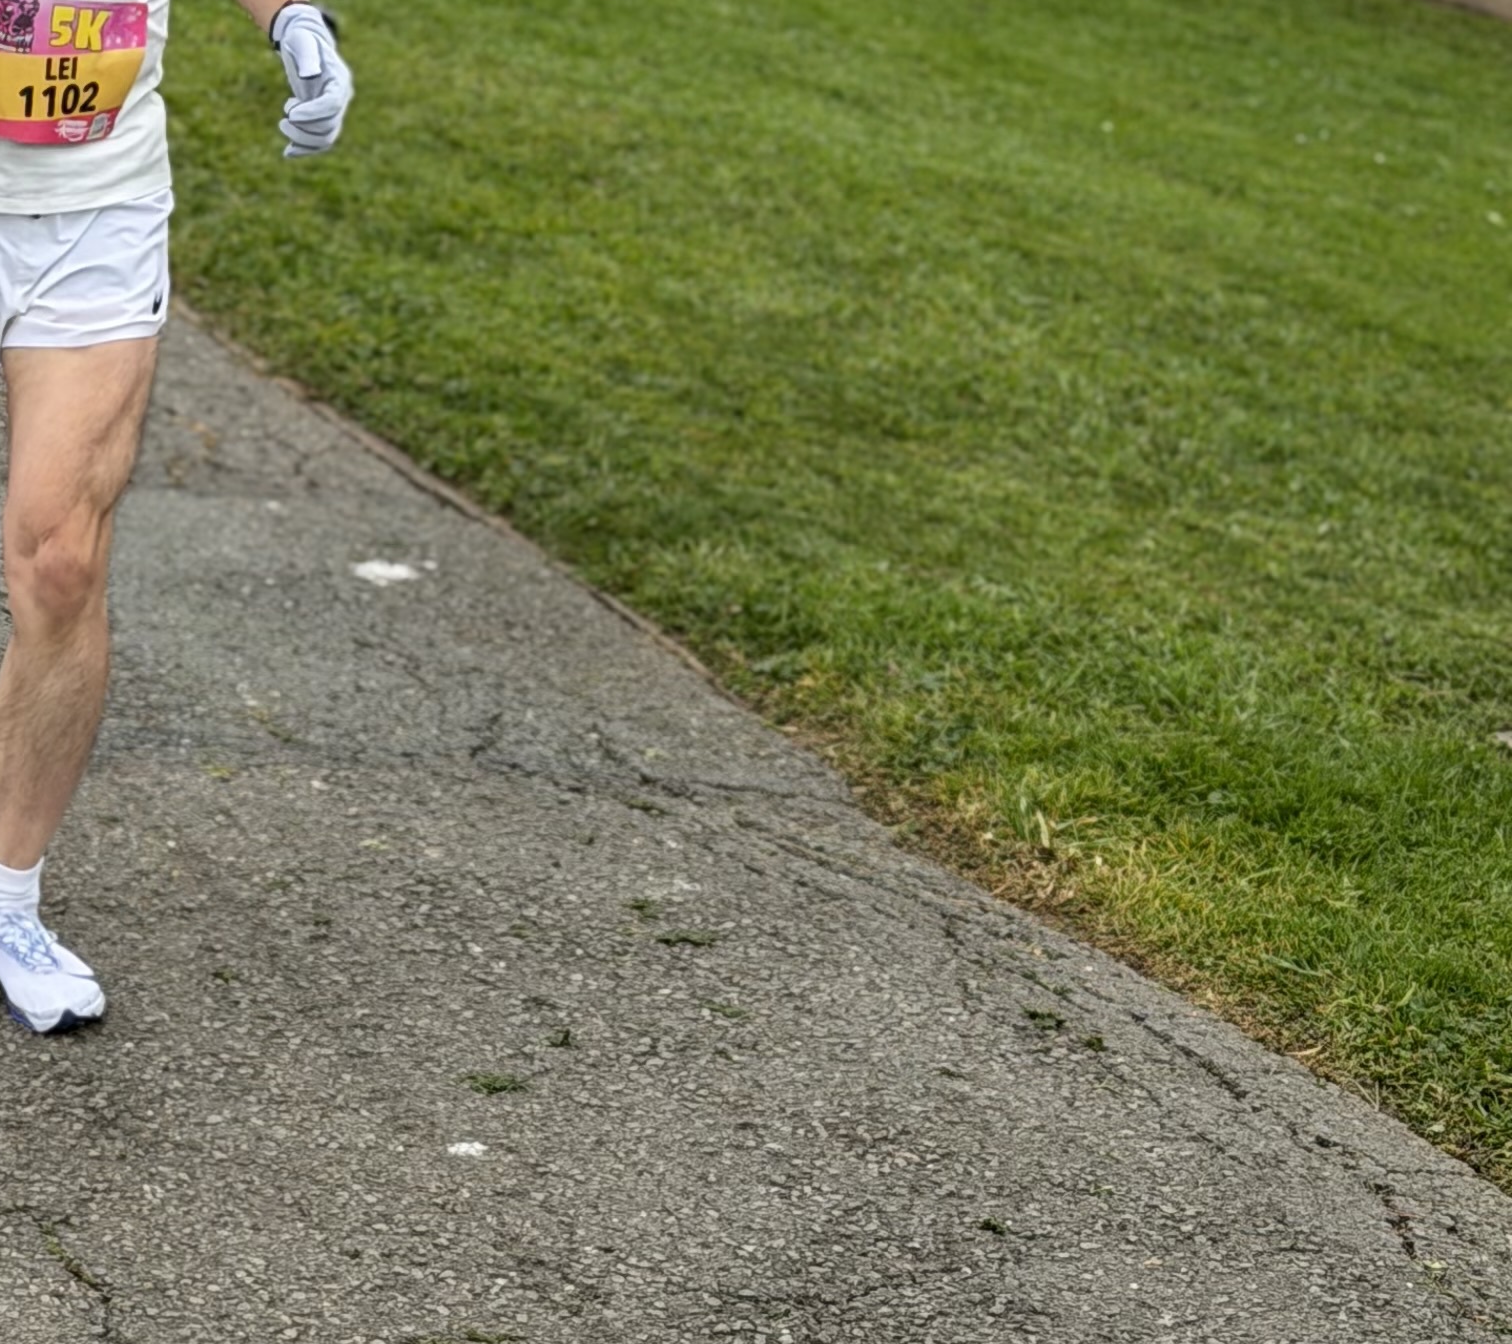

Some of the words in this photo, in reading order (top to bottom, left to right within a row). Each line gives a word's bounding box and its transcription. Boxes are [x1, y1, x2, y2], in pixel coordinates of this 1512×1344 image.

[49, 4, 112, 52] 5K
[45, 56, 78, 81] LEI
[19, 81, 100, 118] 1102
